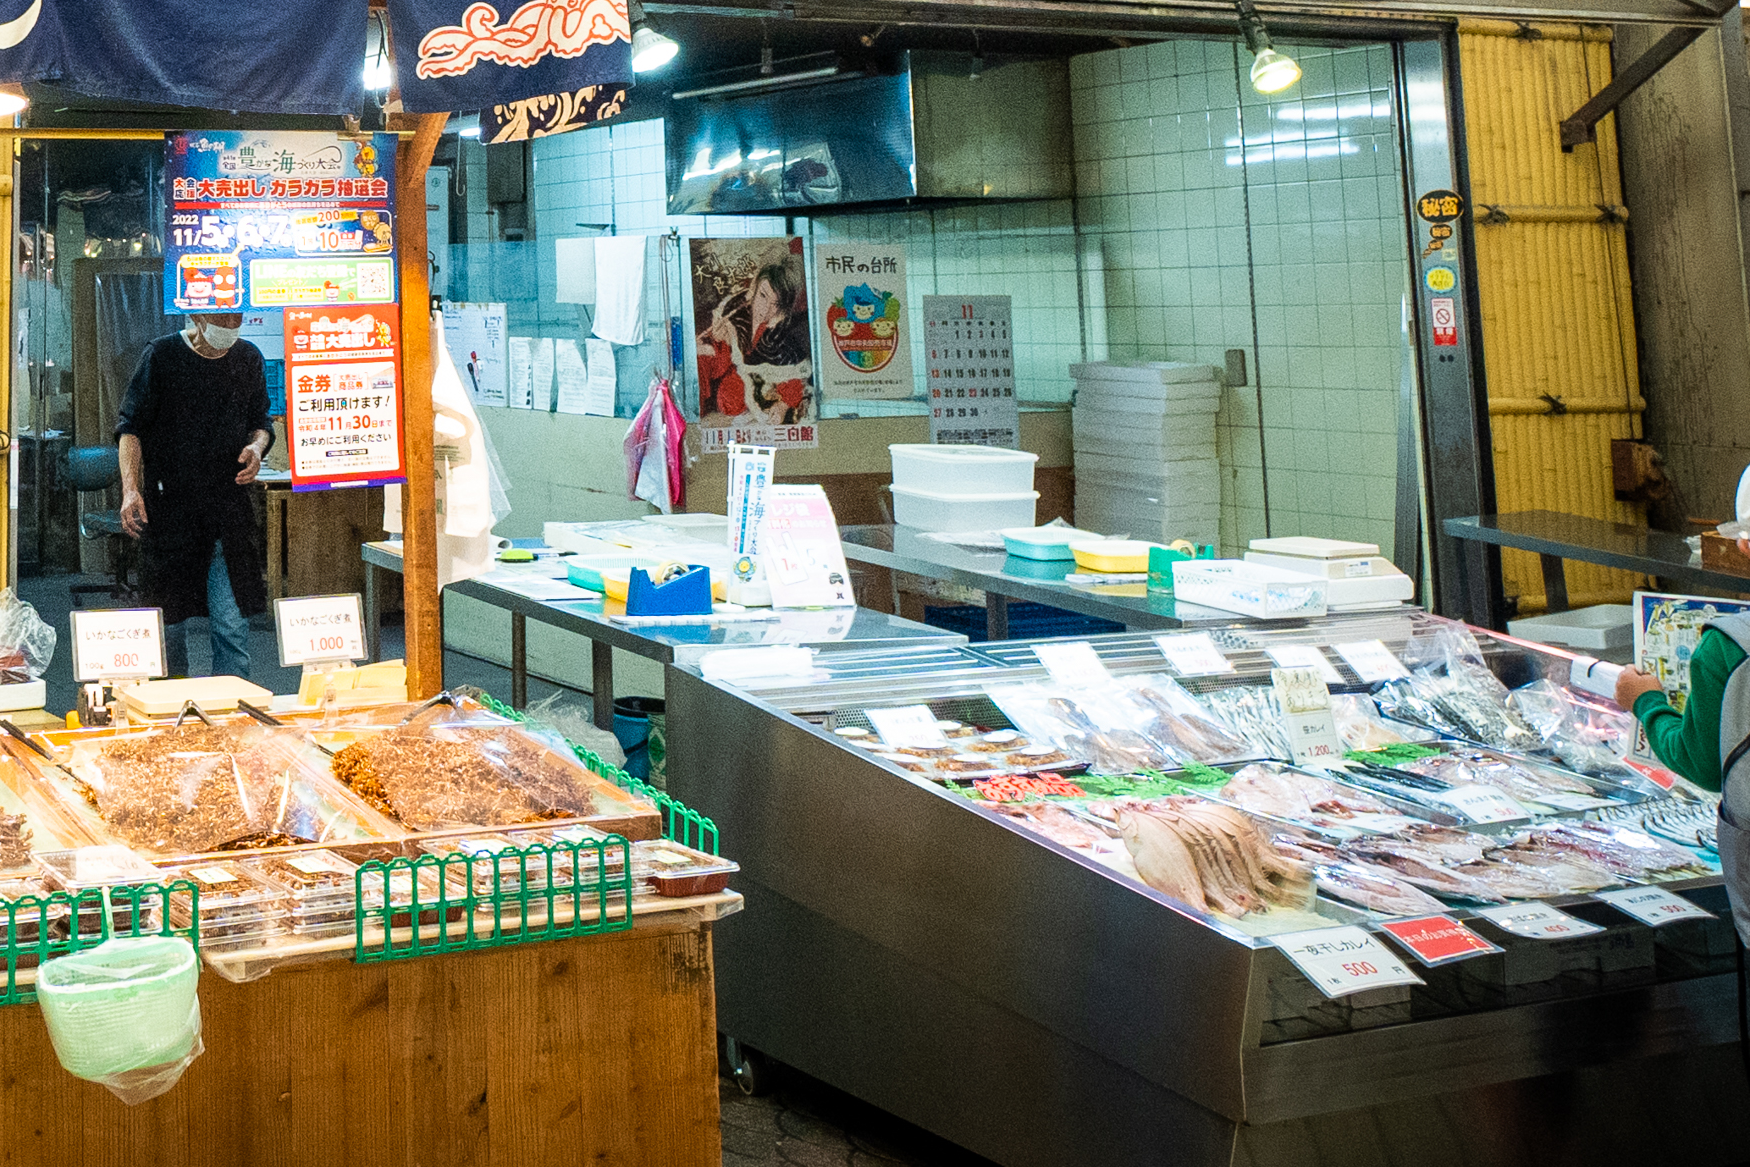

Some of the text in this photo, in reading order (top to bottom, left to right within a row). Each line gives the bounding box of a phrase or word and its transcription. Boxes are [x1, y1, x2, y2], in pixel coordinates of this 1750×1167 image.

[270, 176, 389, 199] ガラガラ抽選会
[172, 214, 199, 225] 2022
[825, 255, 898, 275] 市民の台所
[961, 304, 974, 320] 11
[1001, 349, 1010, 359] 12
[297, 374, 331, 393] 金券
[956, 388, 965, 398] 22
[289, 613, 353, 627] いかなごくぎ煮
[85, 627, 151, 640] いかなごくぎ煮
[309, 636, 345, 652] 1,000
[113, 653, 139, 668] 800
[1308, 744, 1330, 758] 1,200
[973, 772, 1087, 802] おすすめ品
[1659, 904, 1687, 914] 500
[1293, 937, 1376, 956] 一夜干しカレイ
[1342, 960, 1379, 977] 500
[1392, 965, 1406, 975] 円
